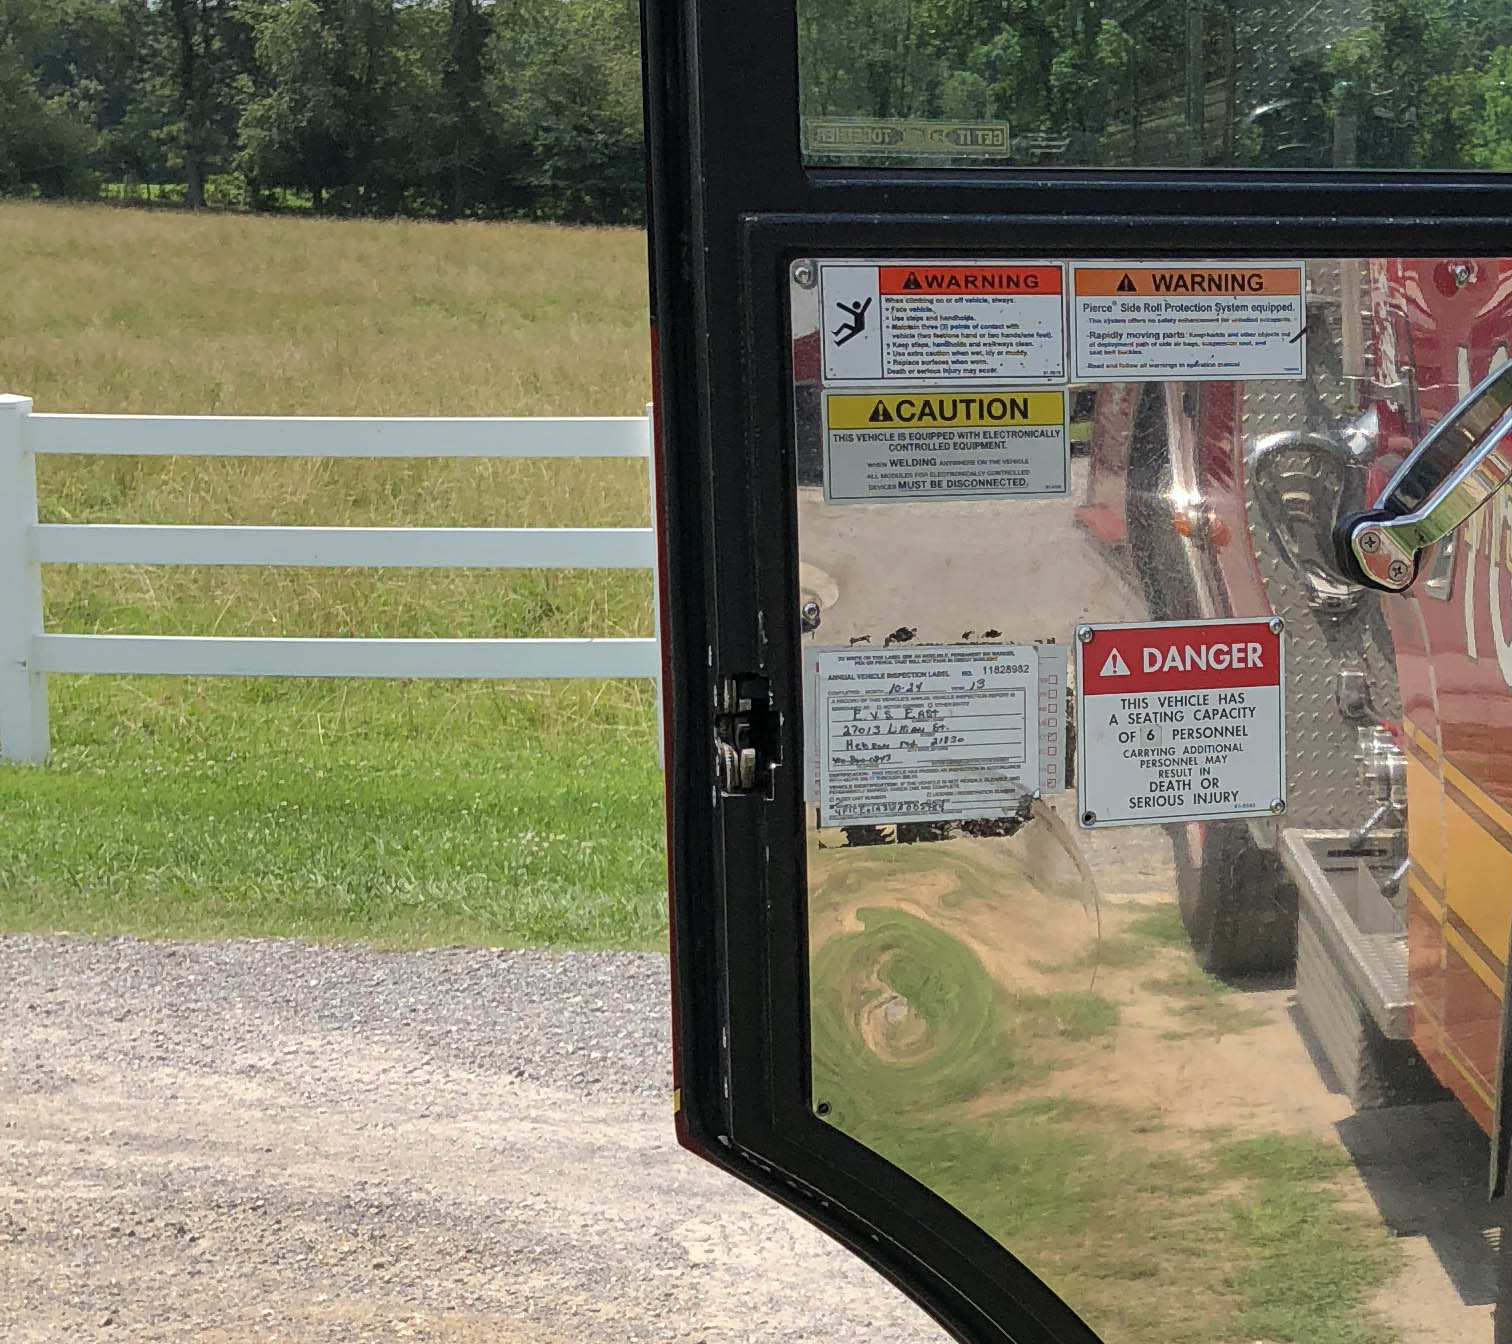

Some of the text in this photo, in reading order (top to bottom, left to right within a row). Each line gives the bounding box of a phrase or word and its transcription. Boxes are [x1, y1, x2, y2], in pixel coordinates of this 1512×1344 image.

[924, 274, 1040, 289] WARNING
[1151, 273, 1264, 292] WARNING
[1120, 303, 1142, 313] Side
[1143, 303, 1163, 313] Roll
[1164, 302, 1213, 313] Protection
[1214, 302, 1249, 314] System
[1251, 302, 1295, 315] equipped.
[1126, 331, 1161, 340] moving
[895, 397, 1029, 422] CAUTION
[833, 428, 1061, 443] THIS VEHICLE IS EQUIPPED WITH ELECTRONICALLY
[888, 442, 950, 452] CONTROLLED
[888, 457, 937, 468] WELDING
[897, 480, 928, 490] MUST
[930, 479, 944, 489] BE
[1143, 642, 1264, 674] DANGER
[1121, 692, 1245, 710] THIS VEHICLE HAS
[1108, 706, 1257, 726] A SEATING CAPACITY
[1118, 725, 1249, 744] OF 6 PERSONNEL
[1123, 743, 1244, 759] CARRYING ADDITIONAL
[1140, 754, 1228, 769] PERSONNEL MAY
[1158, 766, 1211, 779] RESULT IN
[1149, 777, 1220, 793] DEATH OR
[1129, 793, 1185, 810] SERIOUS
[1193, 790, 1240, 805] INJURY
